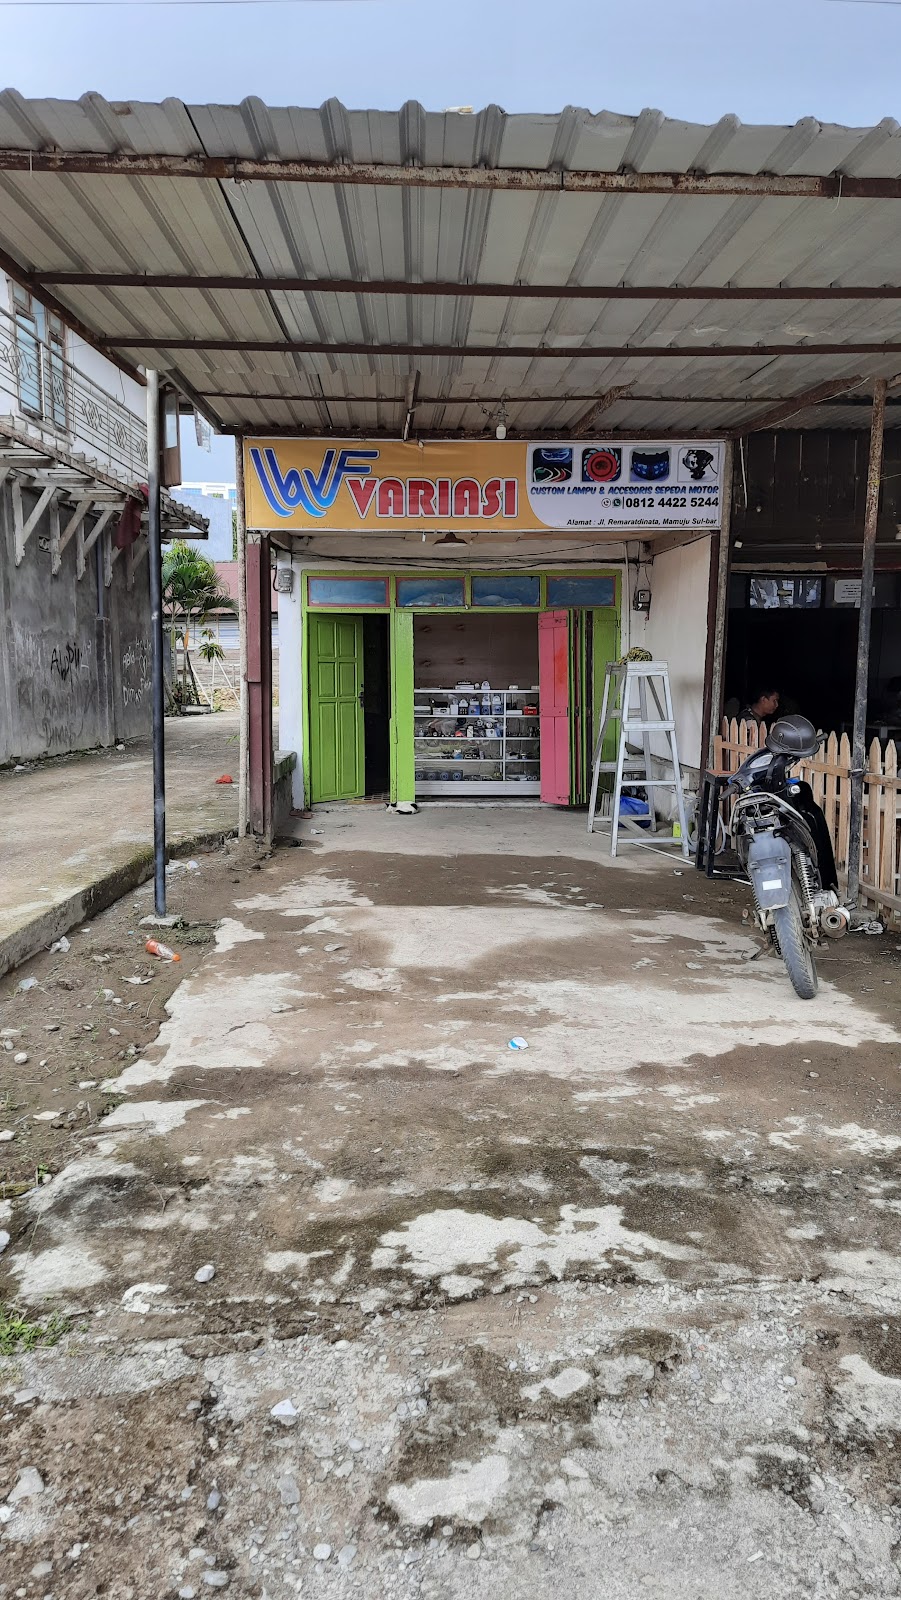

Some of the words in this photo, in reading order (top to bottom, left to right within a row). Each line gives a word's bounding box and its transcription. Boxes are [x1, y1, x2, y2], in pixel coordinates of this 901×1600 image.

[530, 486, 566, 496] CUSTOM
[566, 486, 597, 495] LAMPU
[598, 486, 605, 495] &
[607, 486, 653, 495] ACCESORIS
[654, 485, 687, 495] SEPEDA
[688, 485, 719, 495] MOTOR
[347, 477, 519, 520] VARIASI
[625, 497, 655, 508] 0812
[658, 497, 687, 508] 4422
[690, 496, 719, 508] 5244
[662, 518, 690, 527] Mamuju
